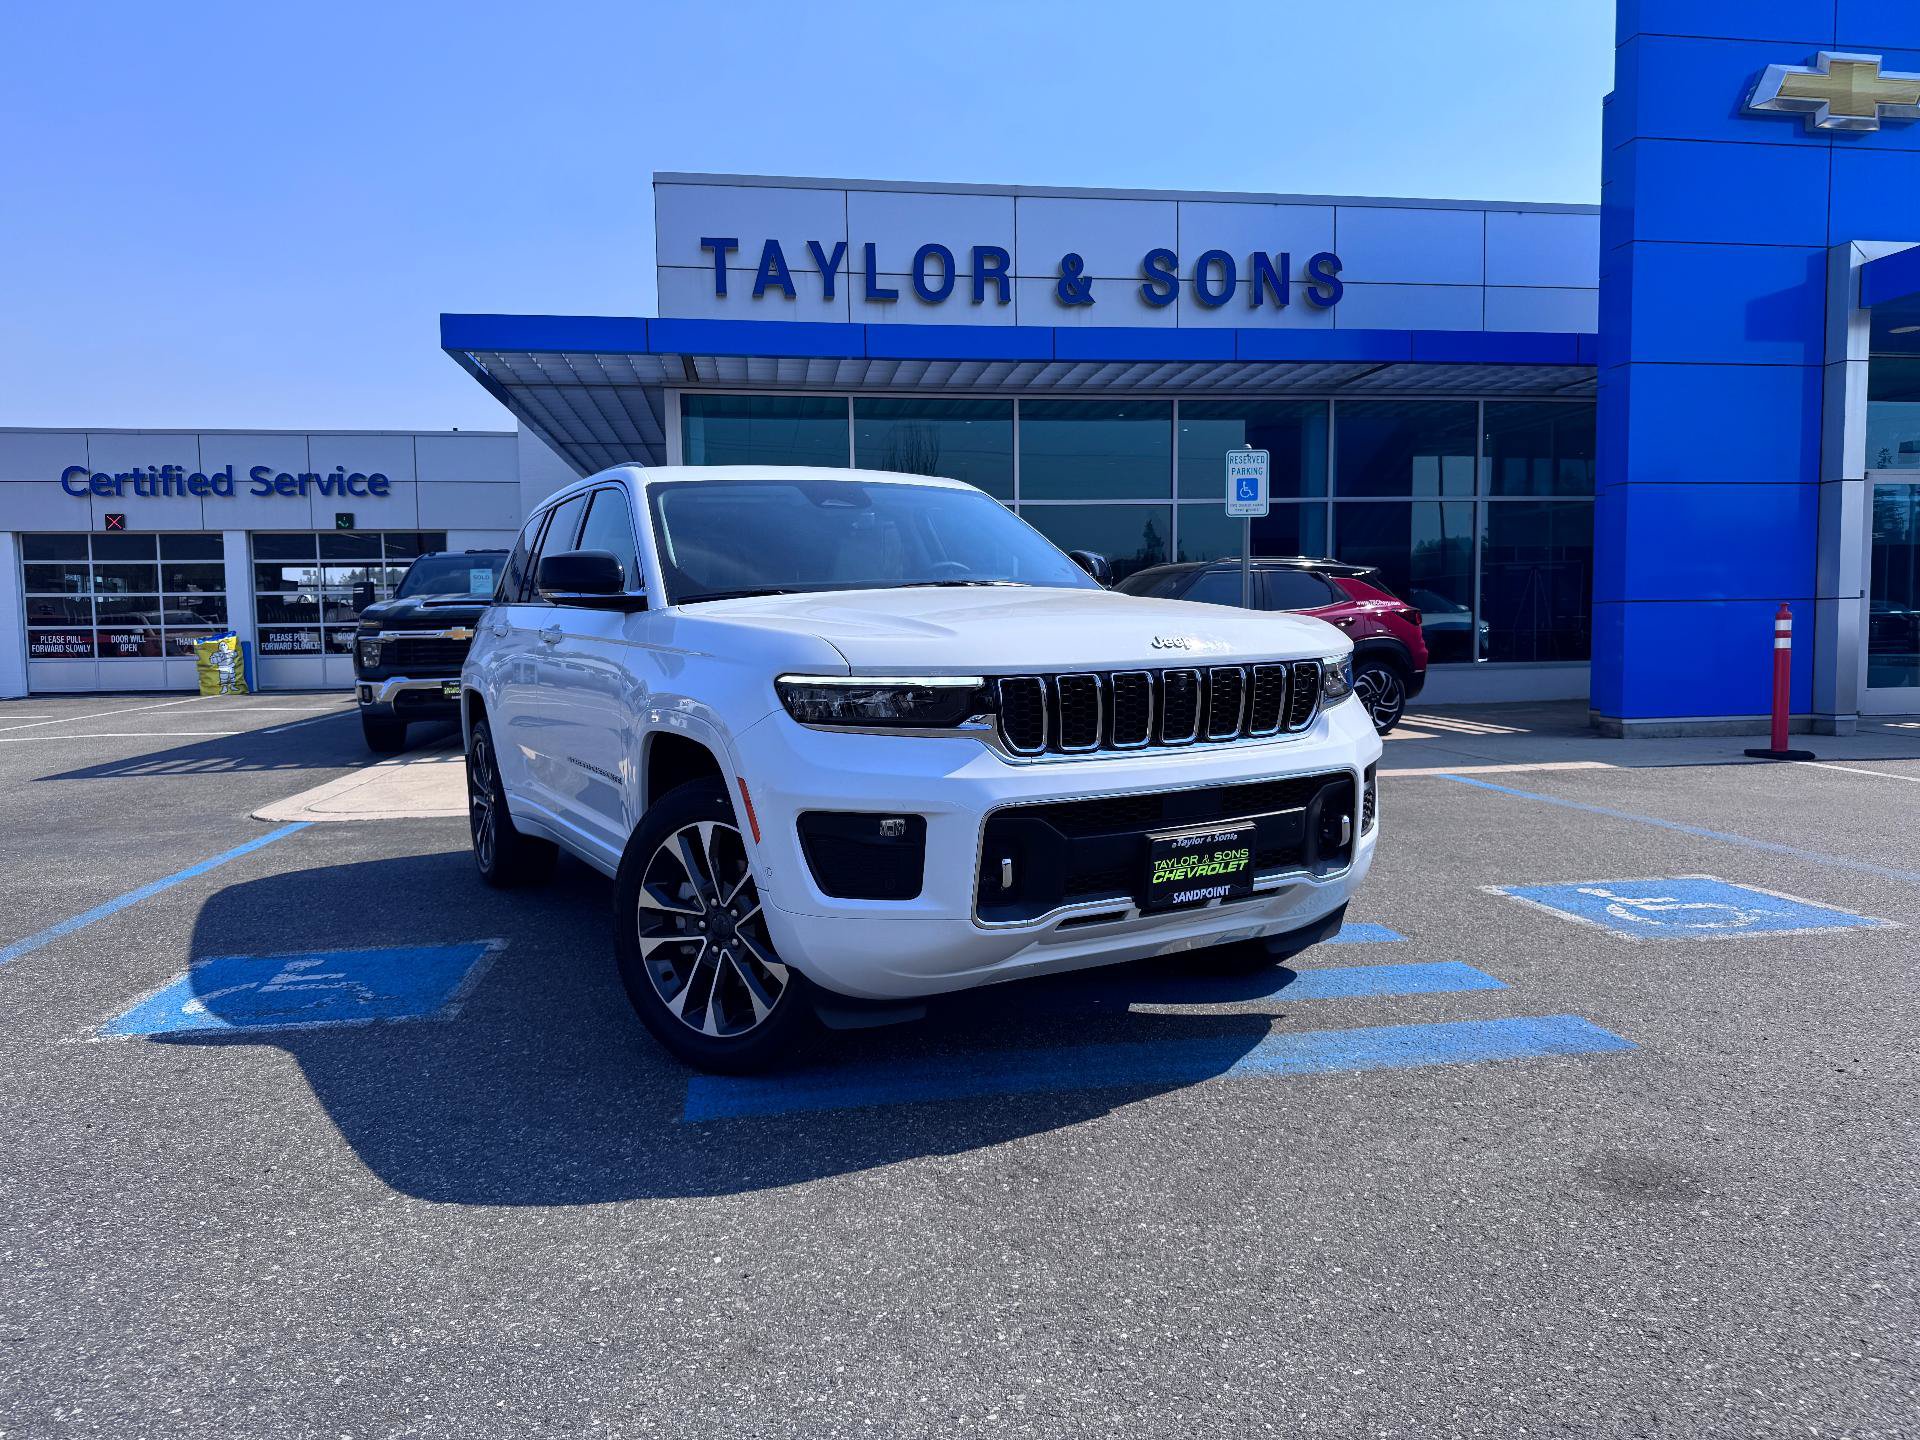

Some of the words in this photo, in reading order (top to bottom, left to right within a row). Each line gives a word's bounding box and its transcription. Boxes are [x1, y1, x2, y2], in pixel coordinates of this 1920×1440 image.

[700, 237, 1012, 305] TAYLOR
[1056, 252, 1096, 307] &
[1138, 248, 1344, 310] SONS
[1229, 455, 1265, 464] RESERVED
[1231, 467, 1263, 476] PARKING
[61, 464, 236, 497] Certified
[249, 465, 391, 497] Service
[40, 635, 65, 643] PLEASE
[111, 635, 129, 643] DOOR
[129, 635, 146, 643] WILL
[269, 633, 293, 641] PLEASE
[120, 643, 138, 652] OPEN
[261, 642, 293, 650] FORWARD
[1150, 635, 1191, 651] Jeep
[31, 644, 64, 653] FORWARD
[65, 644, 91, 653] SLOWLY
[1177, 836, 1205, 848] Taylor
[1213, 833, 1234, 842] Sons
[1153, 855, 1199, 870] TAYLOR
[1202, 854, 1210, 865] &
[1213, 848, 1249, 861] SONS
[1152, 860, 1249, 883] CHEVROLET
[1172, 885, 1231, 904] SANDPOINT
